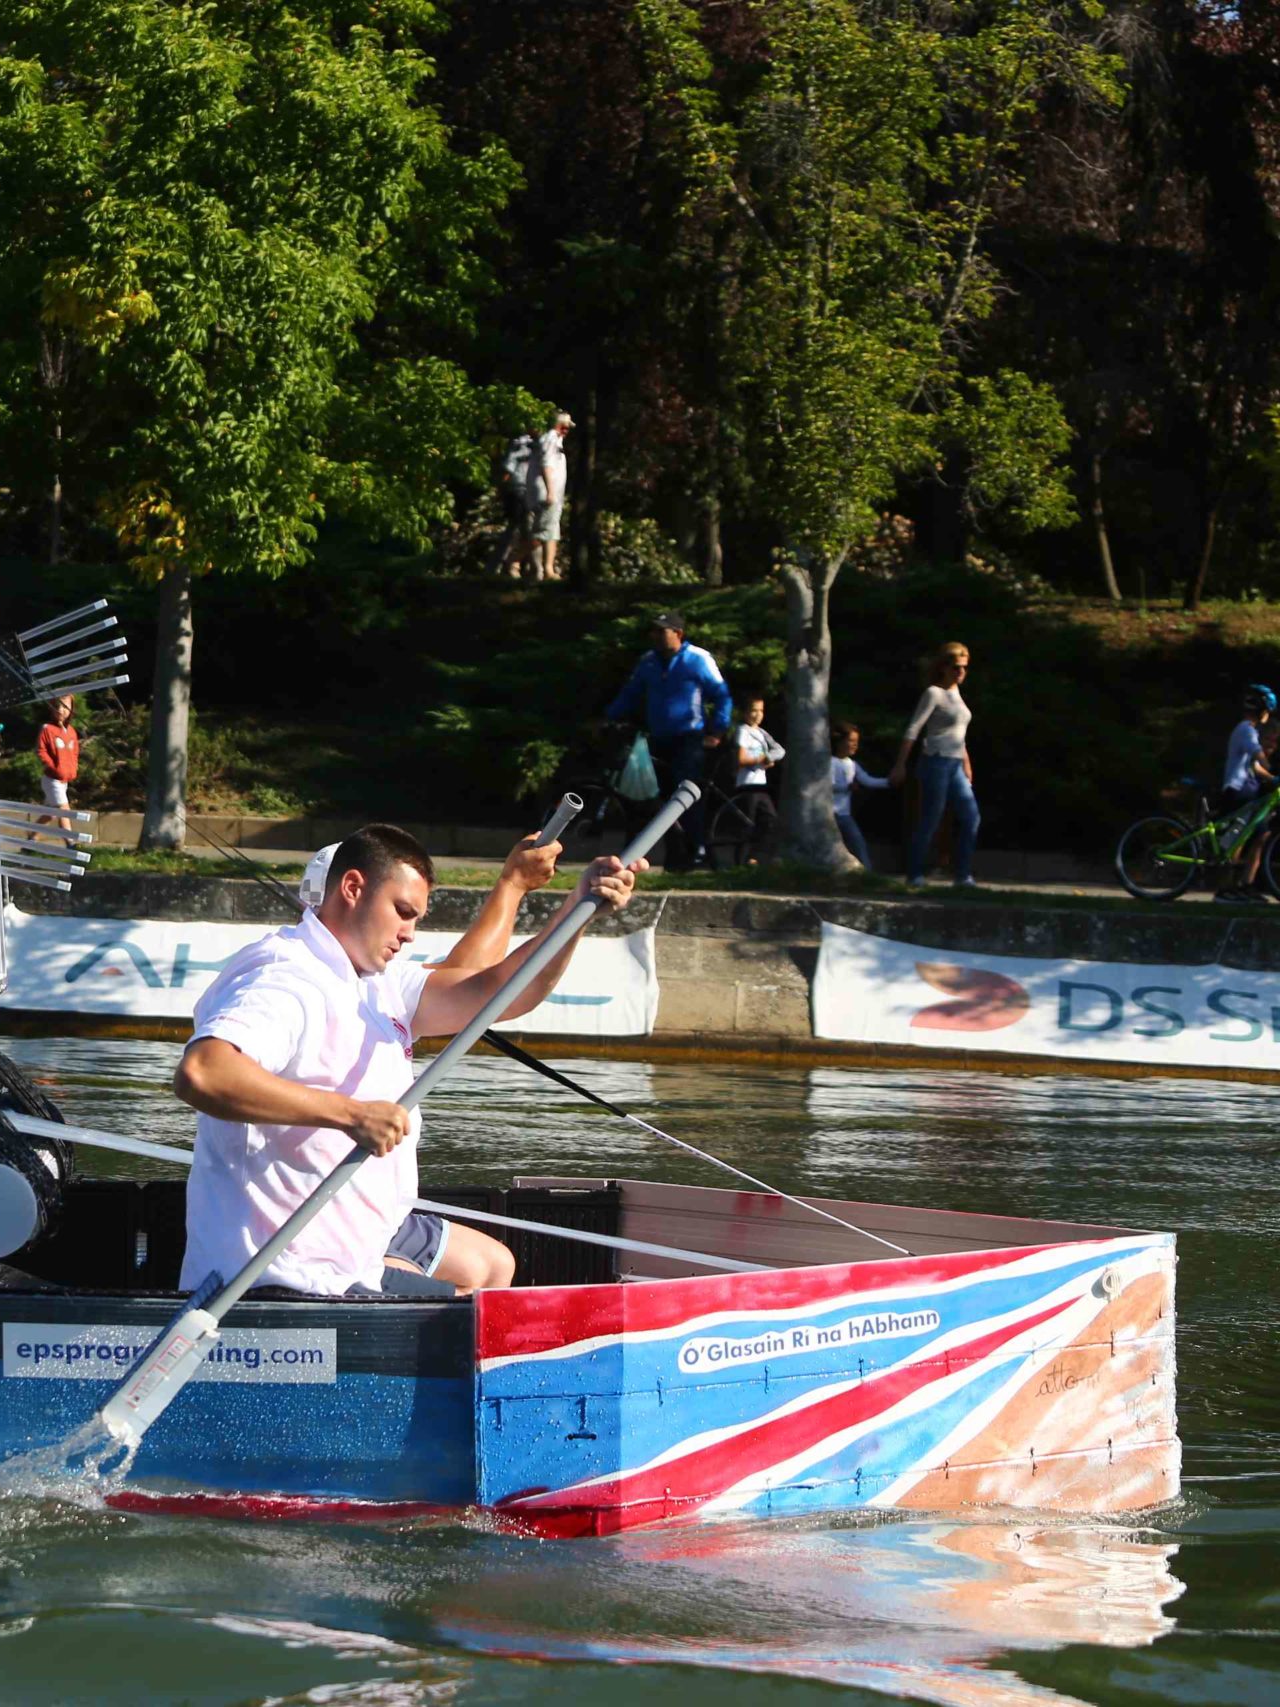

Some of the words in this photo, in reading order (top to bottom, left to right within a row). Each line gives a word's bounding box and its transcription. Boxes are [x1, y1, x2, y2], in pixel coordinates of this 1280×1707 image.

[1058, 979, 1184, 1038] DS
[1207, 988, 1280, 1043] S
[792, 1328, 810, 1348] Rí
[816, 1327, 842, 1345] na
[848, 1311, 938, 1338] hAbhann
[16, 1341, 324, 1369] epsprogring.com
